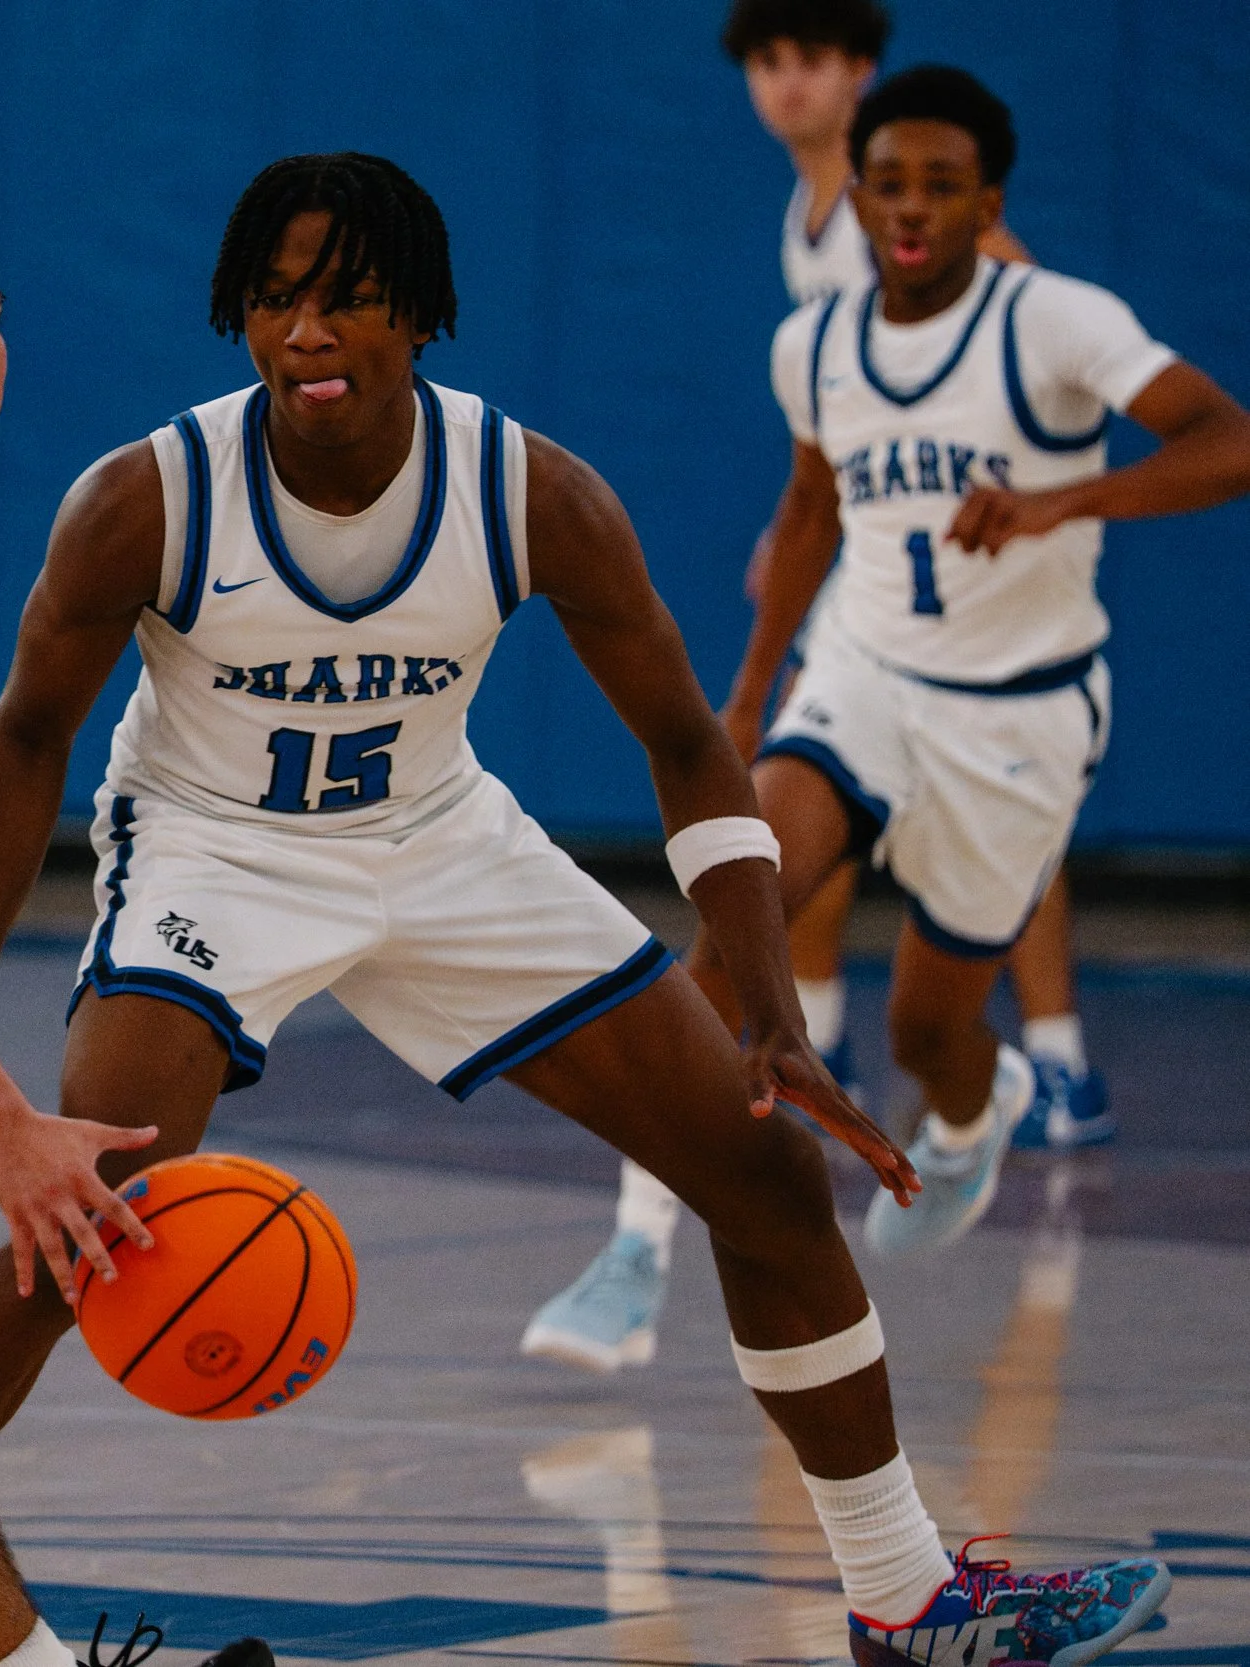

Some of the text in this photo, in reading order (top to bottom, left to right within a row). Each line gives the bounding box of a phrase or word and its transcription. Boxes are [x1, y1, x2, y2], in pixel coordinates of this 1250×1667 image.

[834, 436, 1012, 505] HARKS
[905, 529, 944, 615] 1
[258, 720, 403, 812] 15
